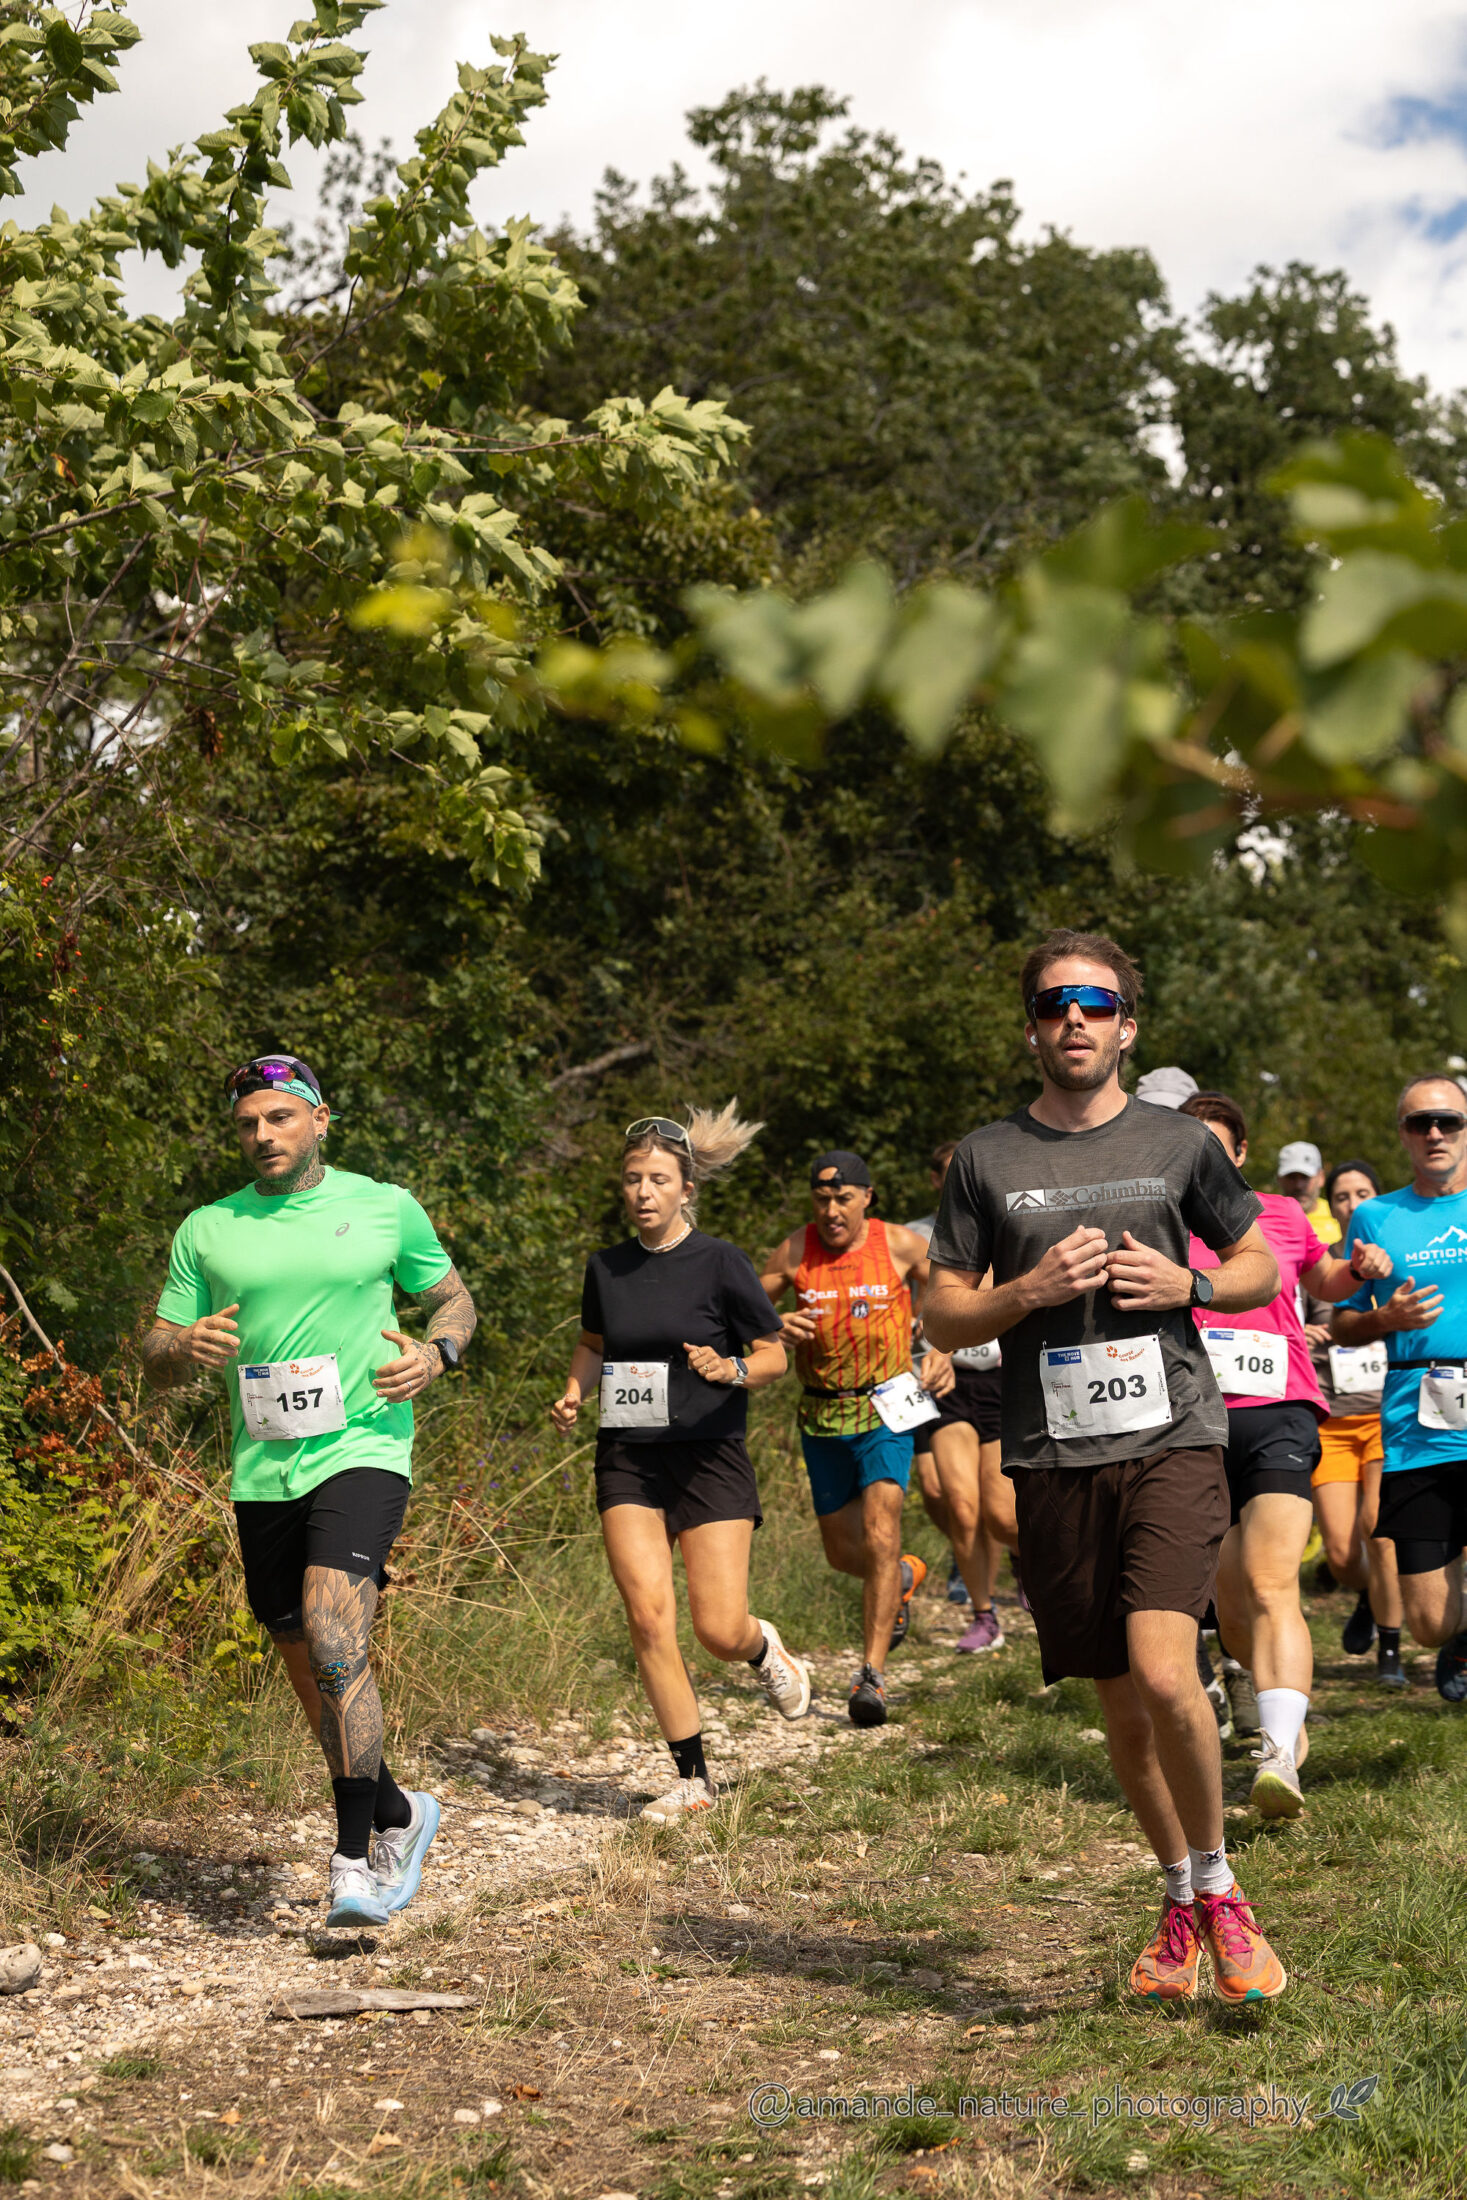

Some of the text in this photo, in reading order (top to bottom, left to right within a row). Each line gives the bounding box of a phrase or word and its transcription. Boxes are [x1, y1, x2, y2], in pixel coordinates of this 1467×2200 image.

[1072, 1181, 1164, 1204] Columbia
[849, 1284, 889, 1298] NEVES
[1234, 1354, 1274, 1375] 108
[276, 1387, 324, 1412] 157
[615, 1388, 654, 1405] 204
[1087, 1374, 1147, 1404] 203
